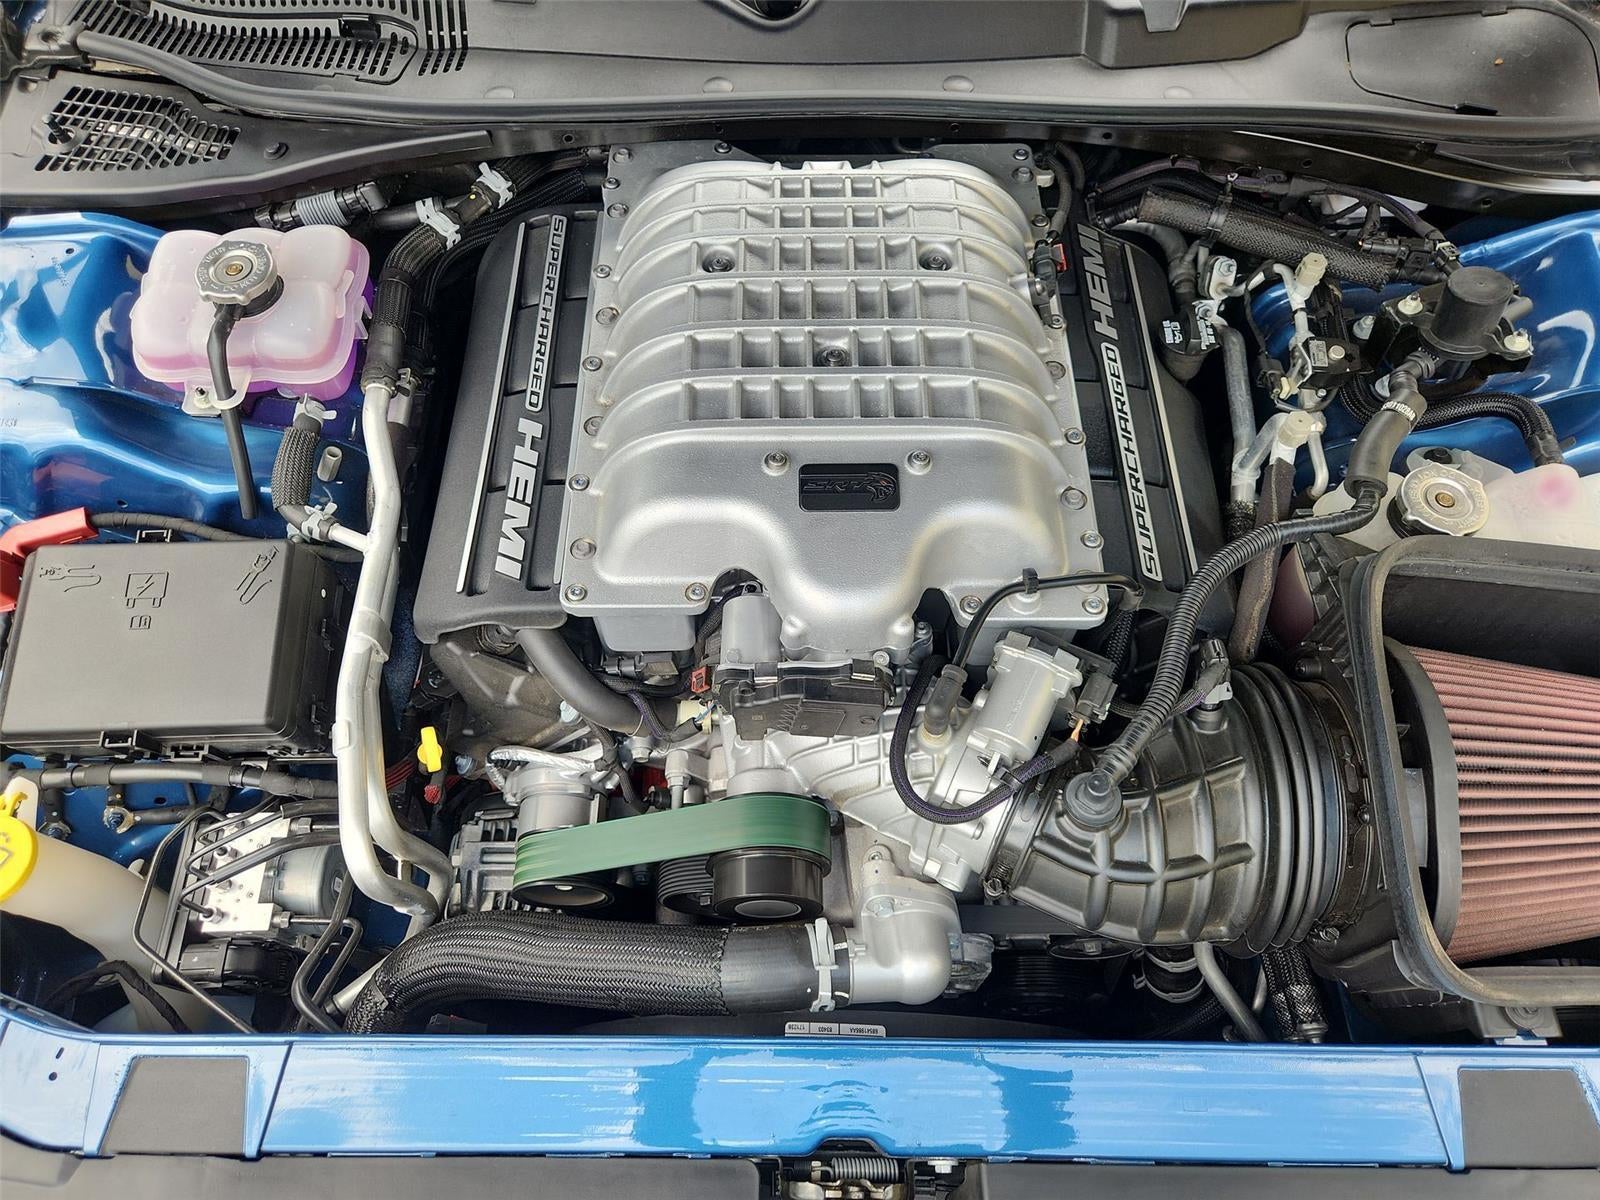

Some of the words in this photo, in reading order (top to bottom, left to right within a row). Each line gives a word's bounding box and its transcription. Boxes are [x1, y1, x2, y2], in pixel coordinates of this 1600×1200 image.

[530, 217, 565, 409] SUPERCHARGED
[1077, 223, 1118, 341] HEMI
[494, 417, 543, 580] HEMI
[1106, 346, 1159, 579] SUPERCHARGED
